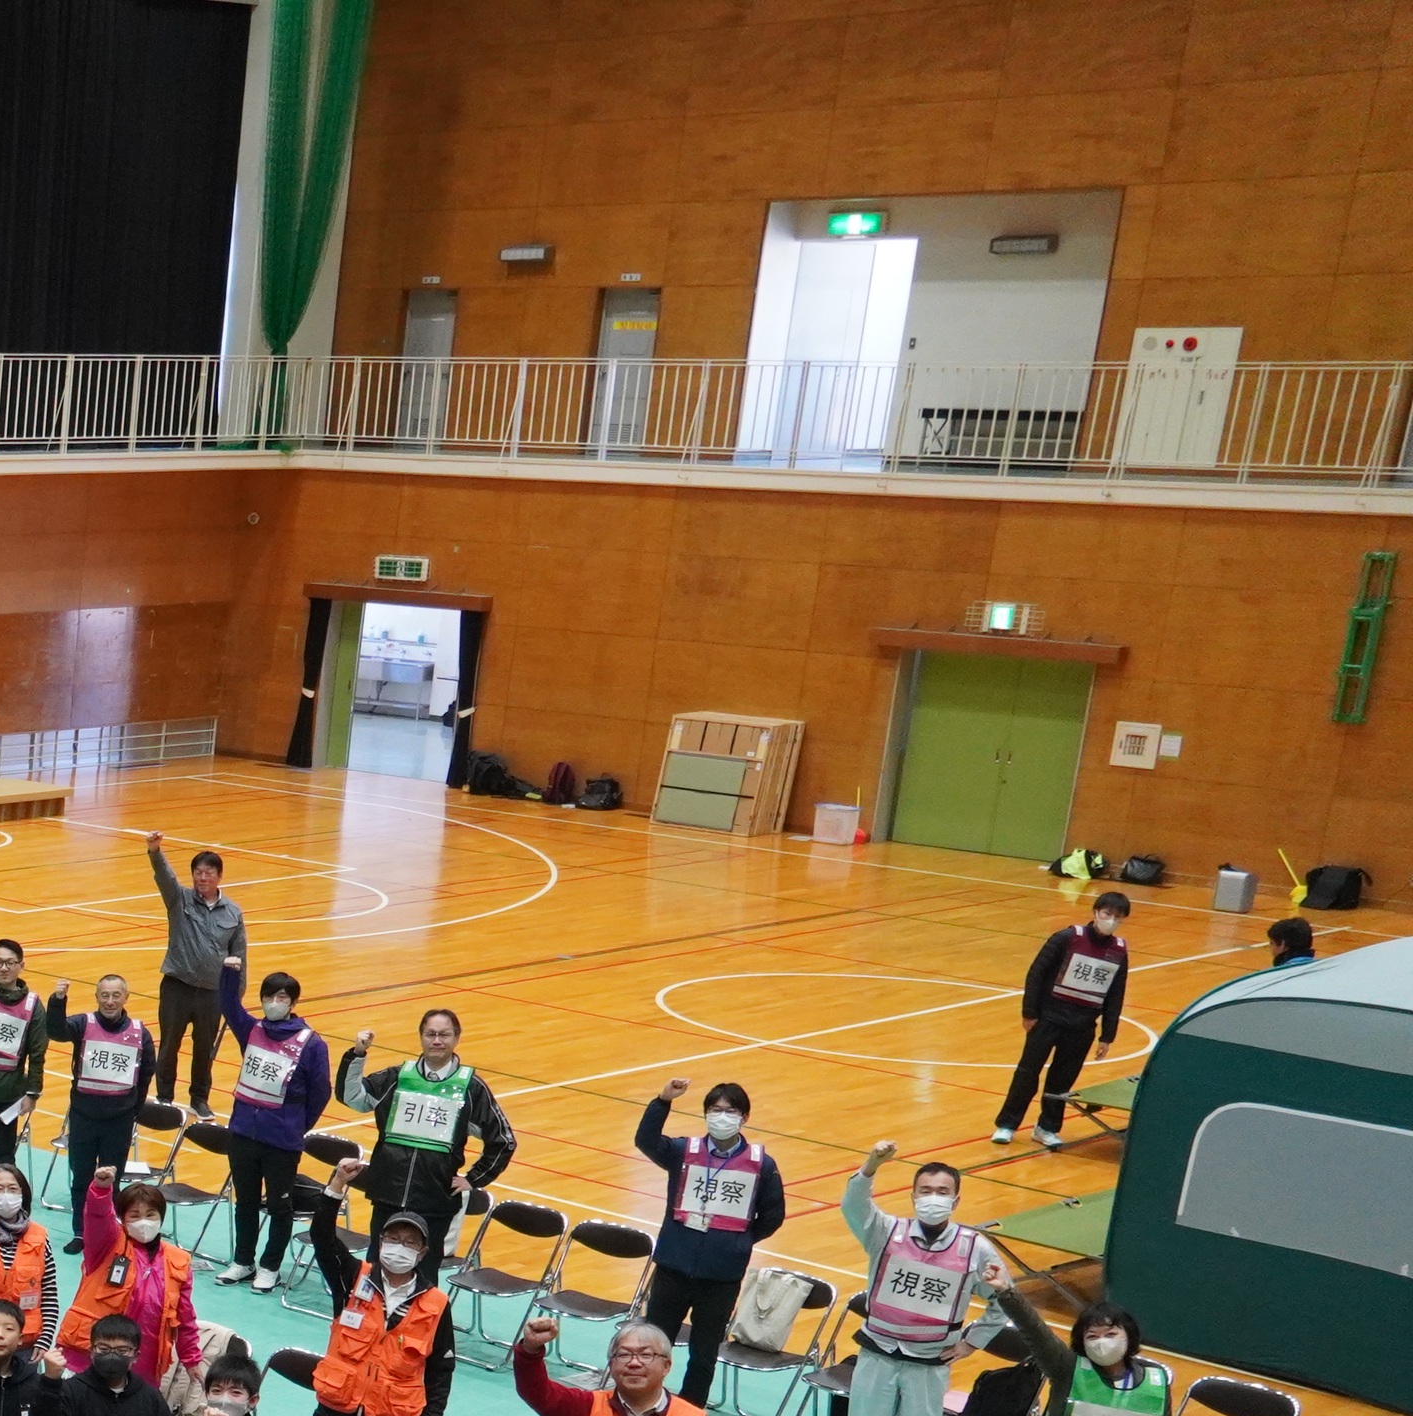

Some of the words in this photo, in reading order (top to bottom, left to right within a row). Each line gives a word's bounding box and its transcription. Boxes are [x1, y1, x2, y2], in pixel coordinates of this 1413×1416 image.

[1073, 961, 1110, 986] 視察
[89, 1049, 130, 1073] 視察
[245, 1053, 282, 1082] 視察
[404, 1102, 450, 1127] 引率
[693, 1176, 746, 1204] 視察
[890, 1268, 951, 1304] 視察
